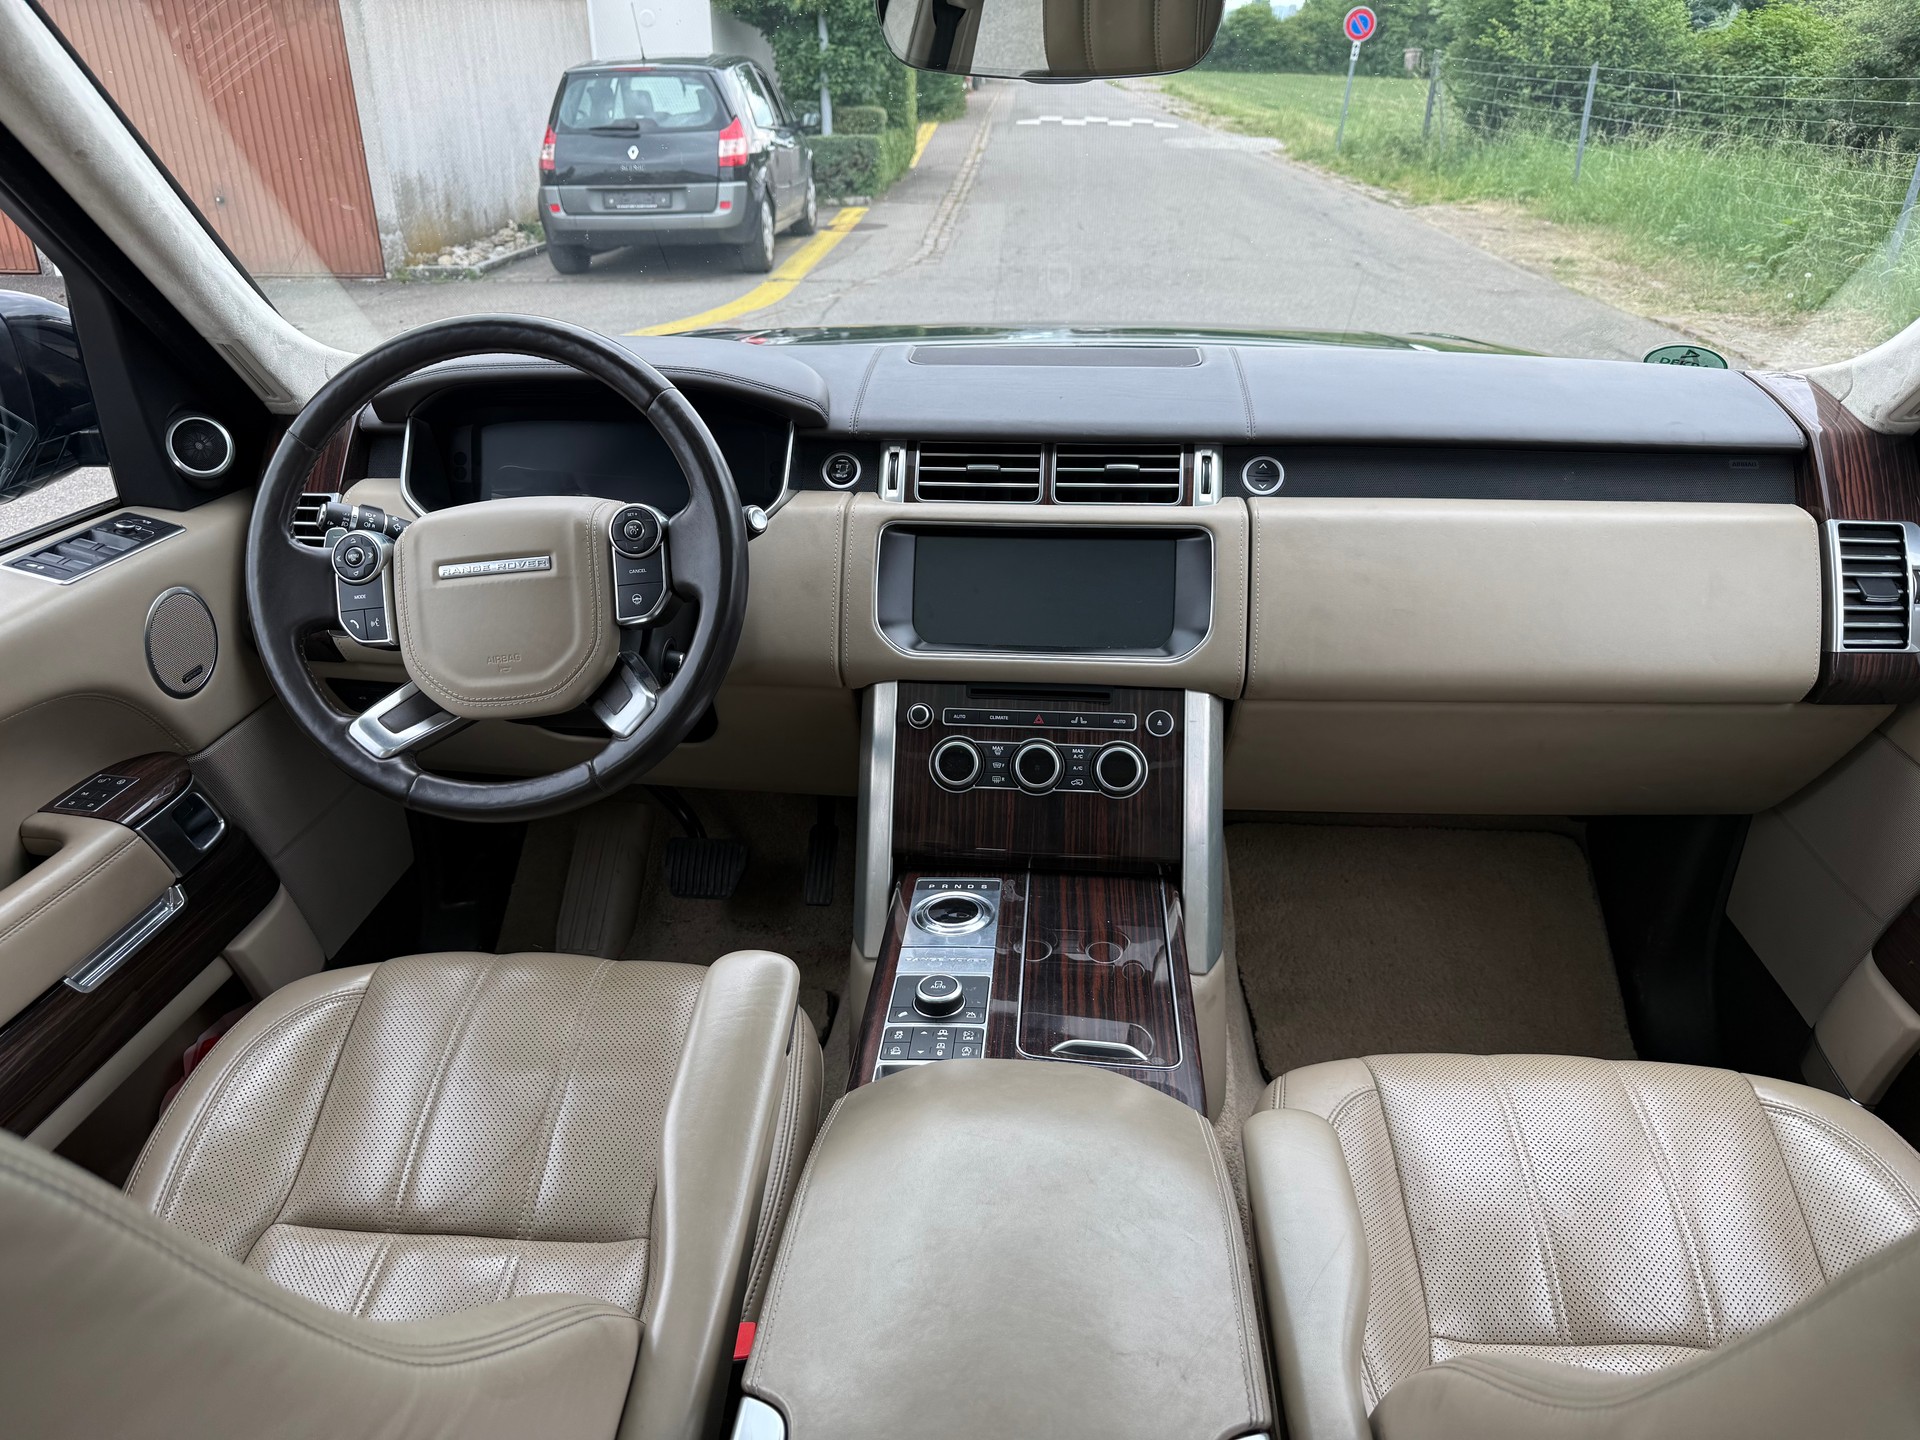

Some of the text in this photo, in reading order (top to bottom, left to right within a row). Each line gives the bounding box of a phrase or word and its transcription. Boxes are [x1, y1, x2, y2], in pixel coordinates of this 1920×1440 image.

[442, 559, 547, 576] RANGE ROVER
[487, 653, 522, 665] AIRBAG
